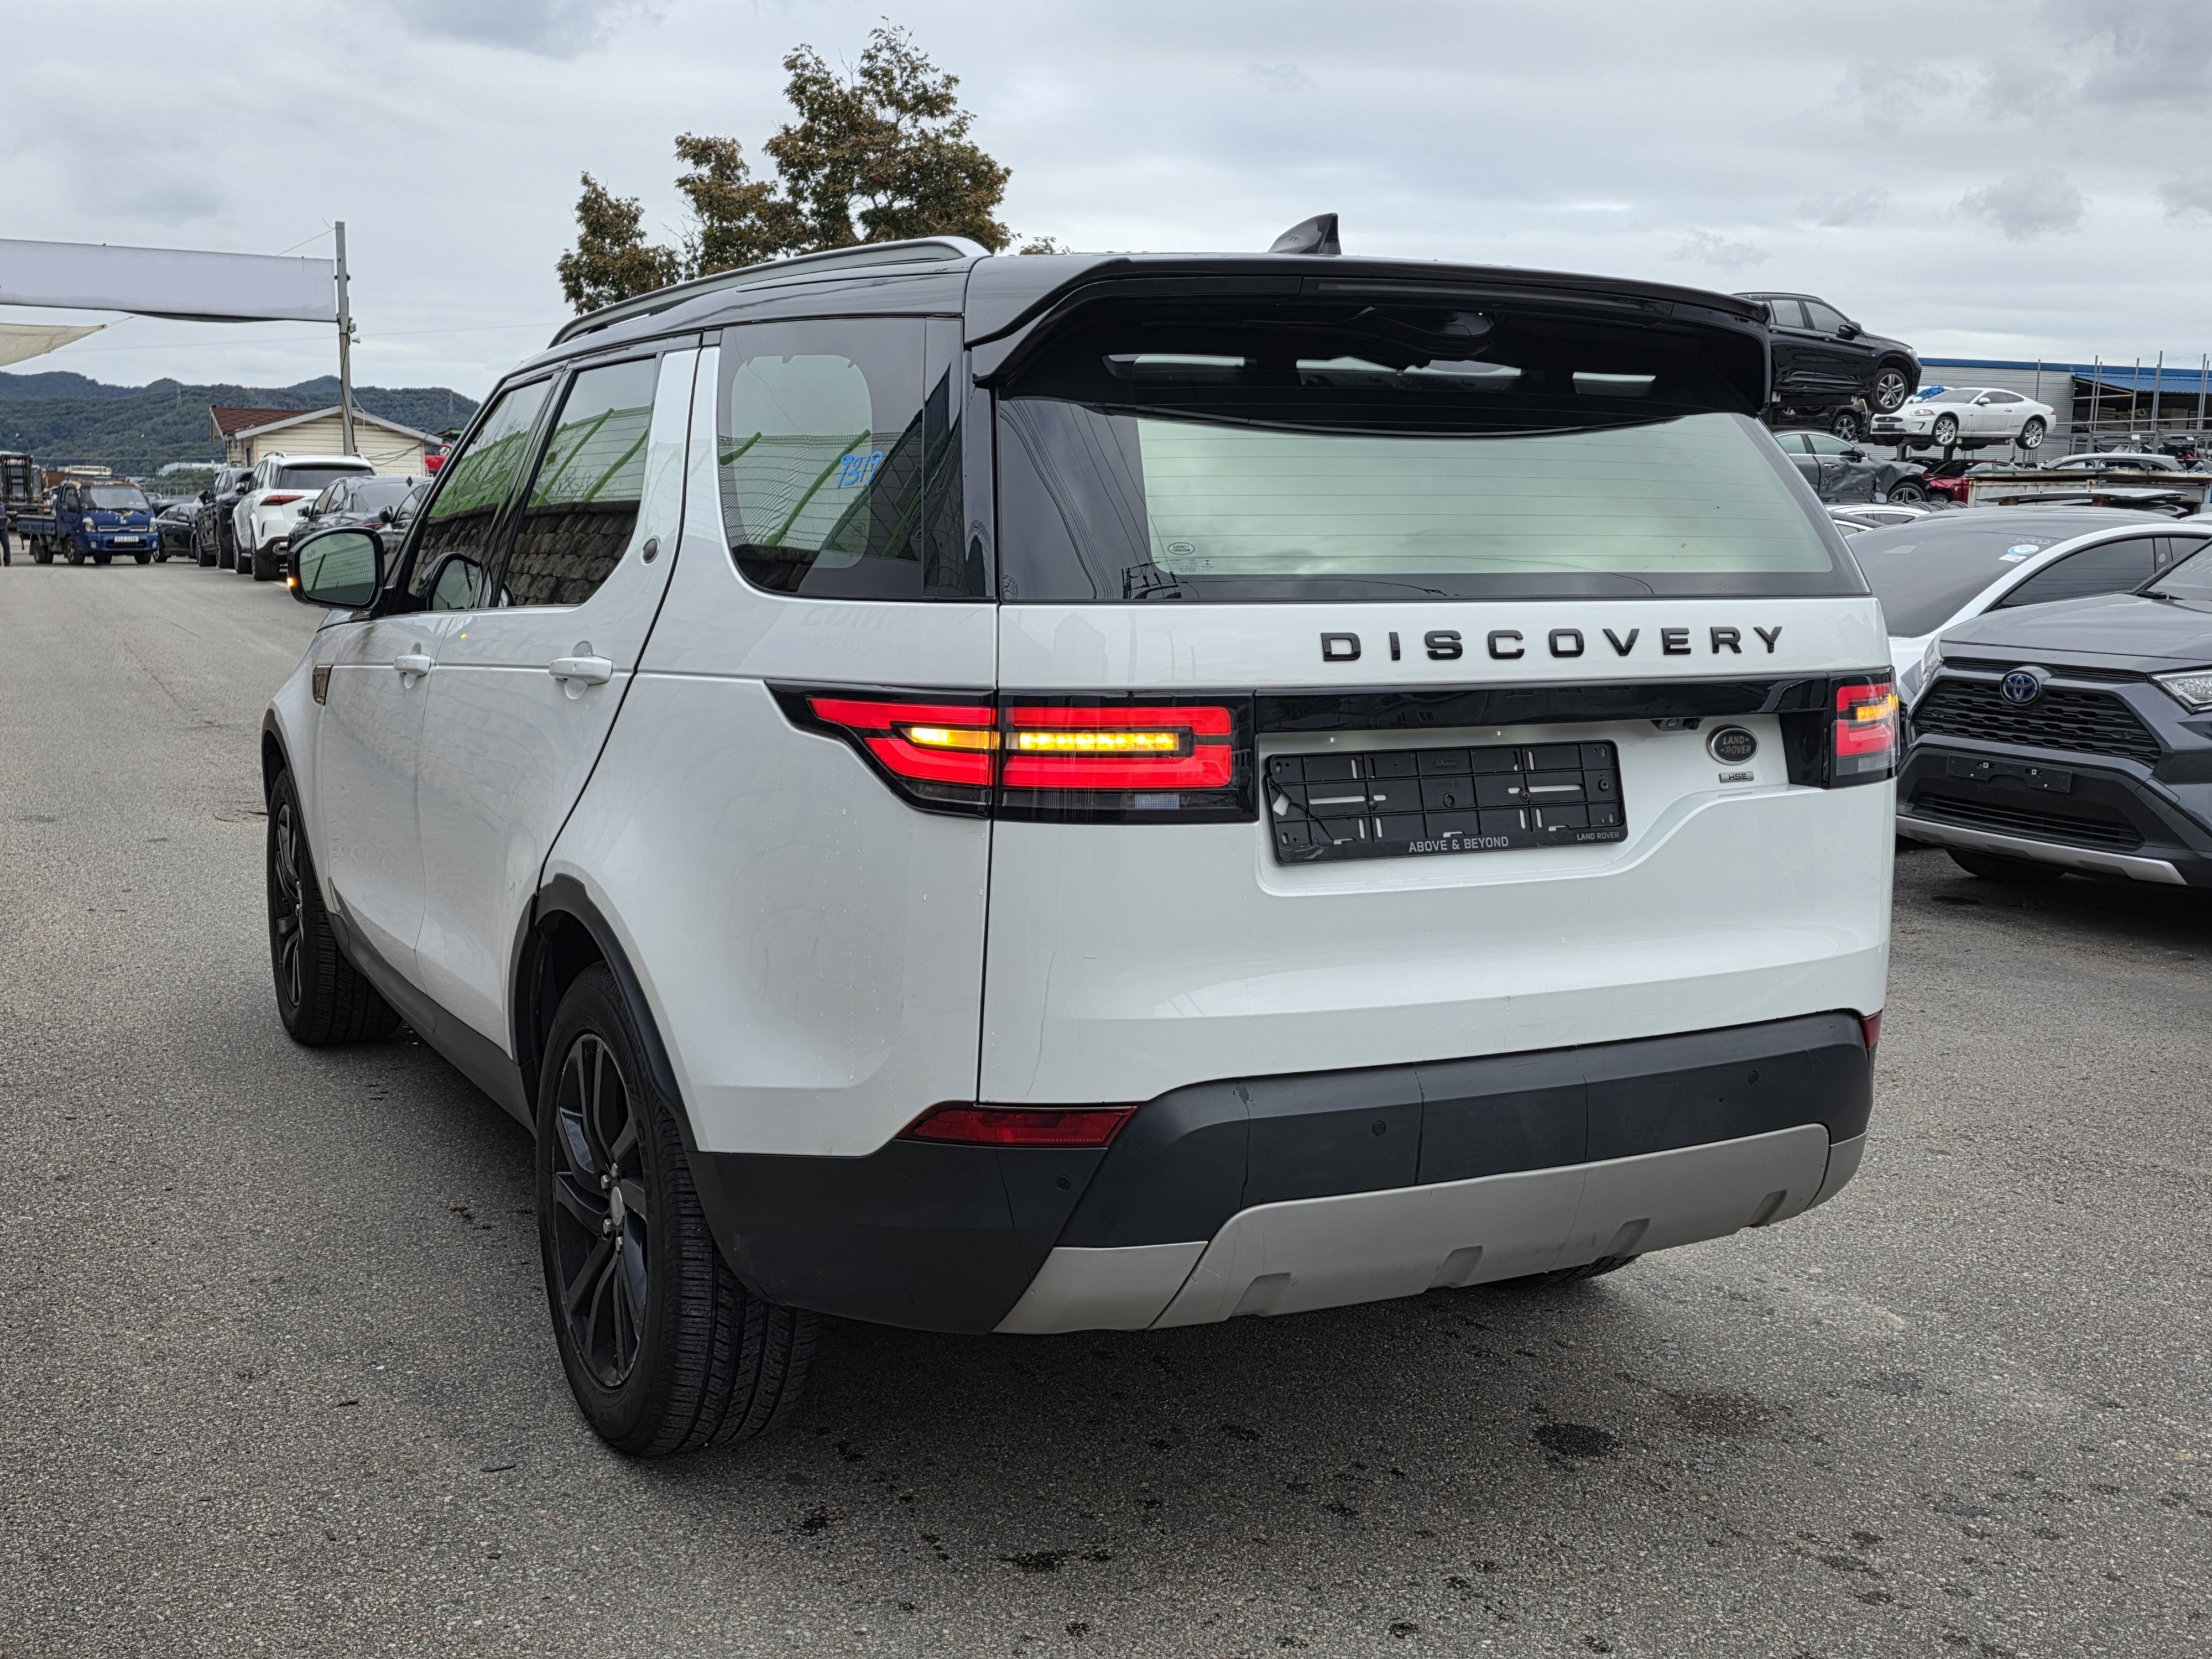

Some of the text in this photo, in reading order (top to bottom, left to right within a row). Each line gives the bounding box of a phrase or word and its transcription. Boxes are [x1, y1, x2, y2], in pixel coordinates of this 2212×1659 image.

[1321, 625, 1783, 661] DISCOVERY
[1723, 735, 1745, 745] LAND
[1725, 745, 1751, 754] ROVER
[1408, 836, 1509, 852] ABOVE & BEYOND
